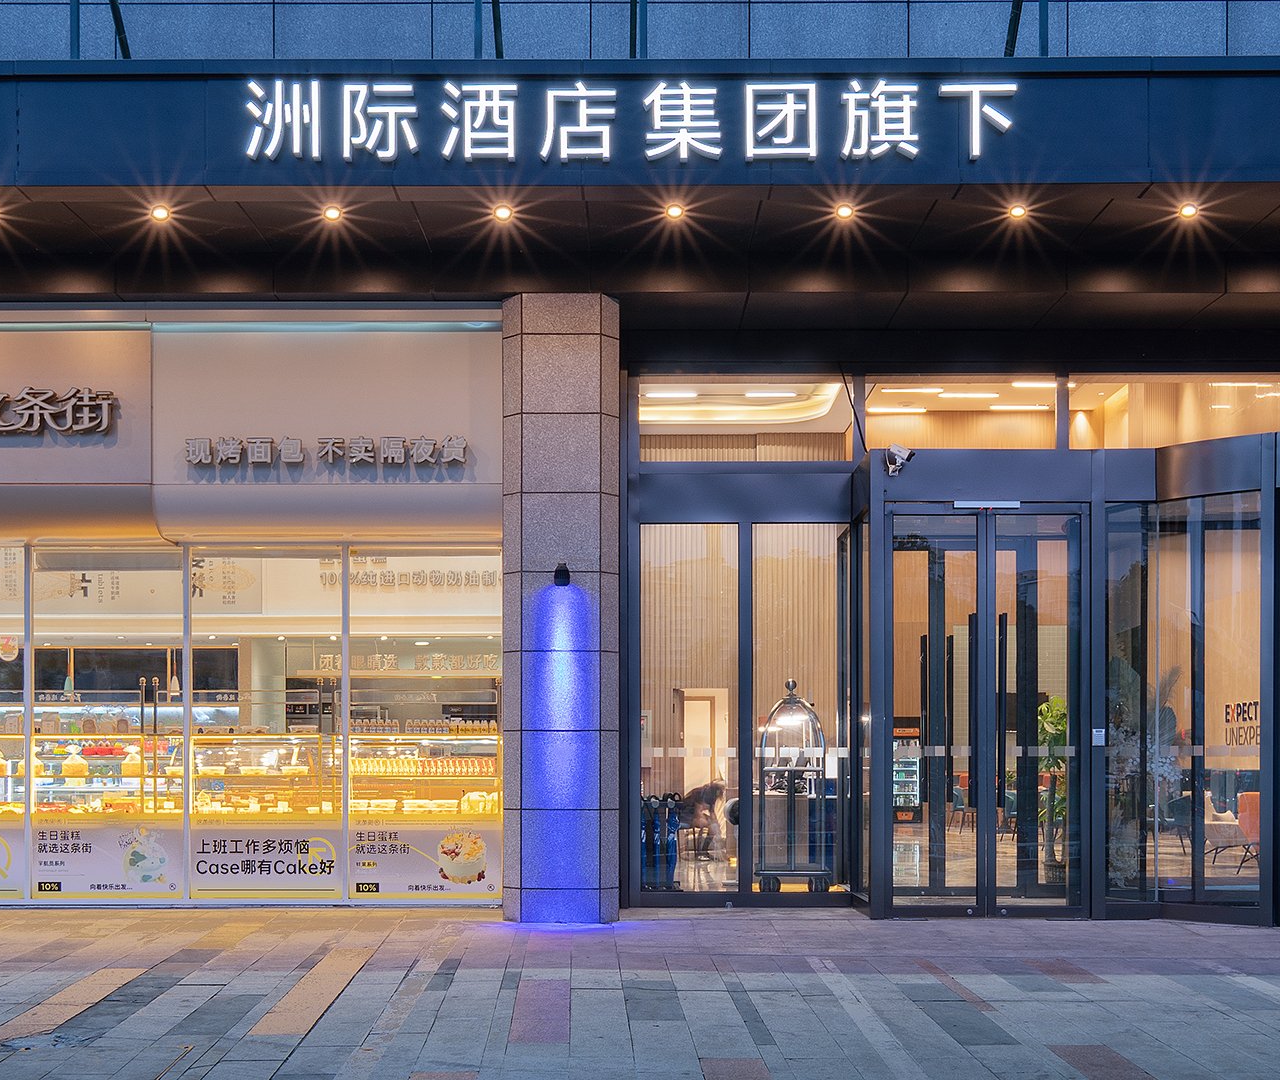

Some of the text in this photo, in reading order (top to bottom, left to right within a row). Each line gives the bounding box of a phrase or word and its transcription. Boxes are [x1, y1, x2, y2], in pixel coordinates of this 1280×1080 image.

[245, 79, 1019, 161] 洲际酒店集团旗下
[186, 435, 468, 466] 现烤面包 不卖隔夜货
[320, 571, 502, 587] 10%纯进口动物奶油制
[1225, 701, 1259, 723] EXPECT
[38, 830, 81, 841] 生日蛋糕
[355, 831, 399, 842] 生日蛋糕
[37, 842, 92, 854] 就选这条街
[196, 838, 310, 855] 上班工作多烦恼
[355, 843, 410, 855] 就选这条街
[40, 883, 59, 891] 10%
[358, 884, 377, 892] 10%
